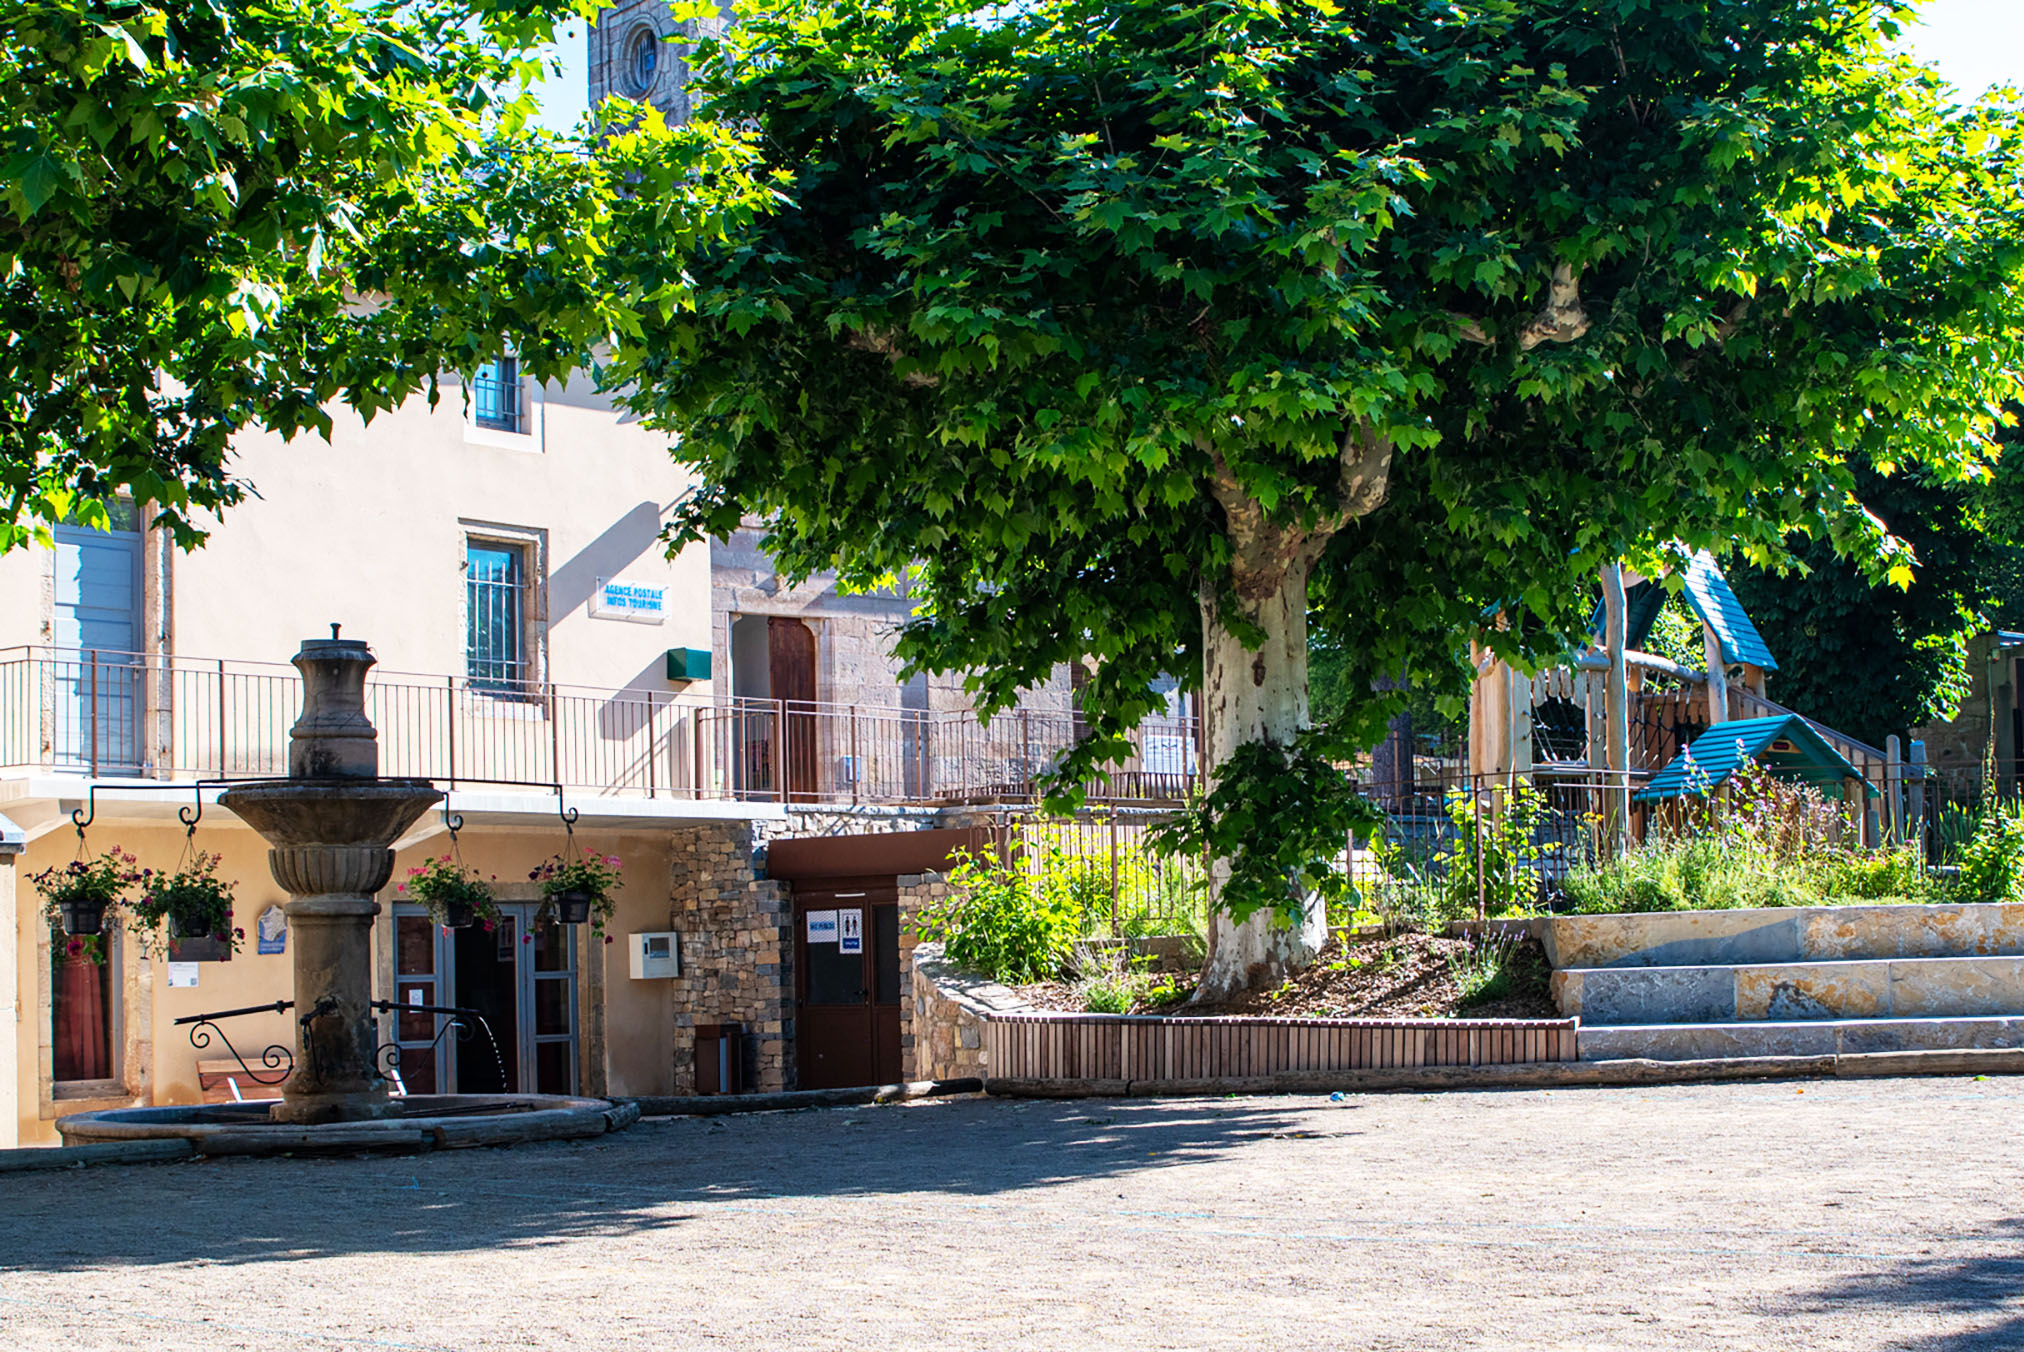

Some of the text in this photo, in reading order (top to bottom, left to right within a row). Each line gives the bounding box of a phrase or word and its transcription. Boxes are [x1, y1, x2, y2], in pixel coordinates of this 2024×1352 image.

[604, 584, 663, 600] AGENCE POSTALE
[628, 597, 662, 611] TOURISME
